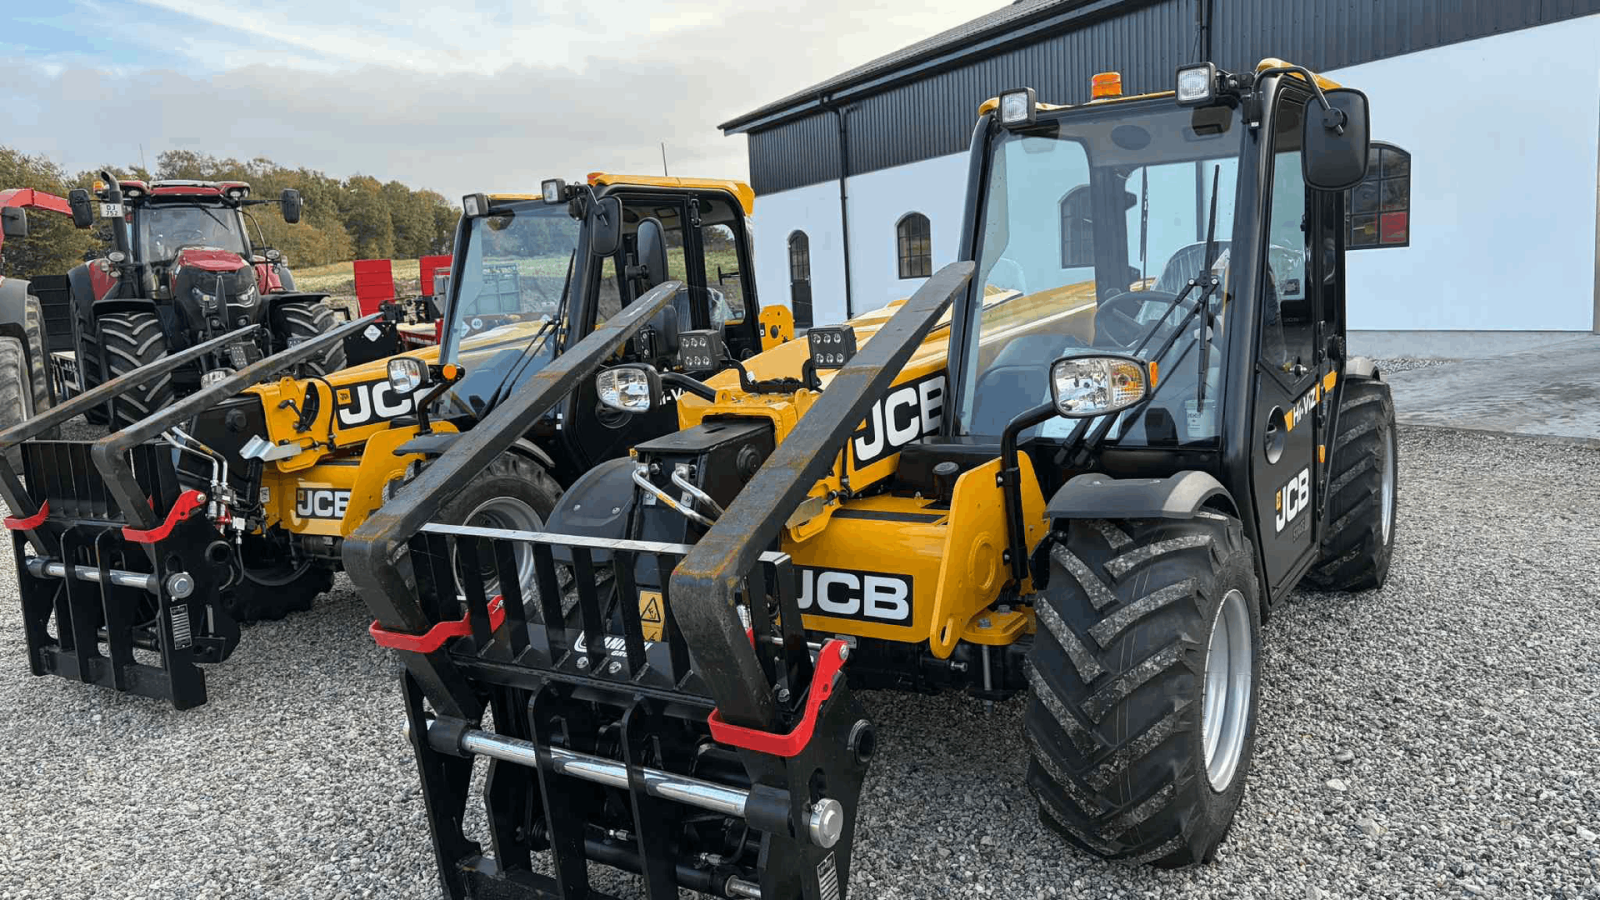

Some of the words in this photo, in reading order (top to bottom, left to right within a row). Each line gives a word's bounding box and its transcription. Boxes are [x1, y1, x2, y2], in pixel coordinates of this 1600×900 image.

[854, 375, 945, 461] JCB
[297, 490, 351, 518] JCB
[1276, 467, 1309, 533] JCB
[796, 569, 909, 621] JCB
